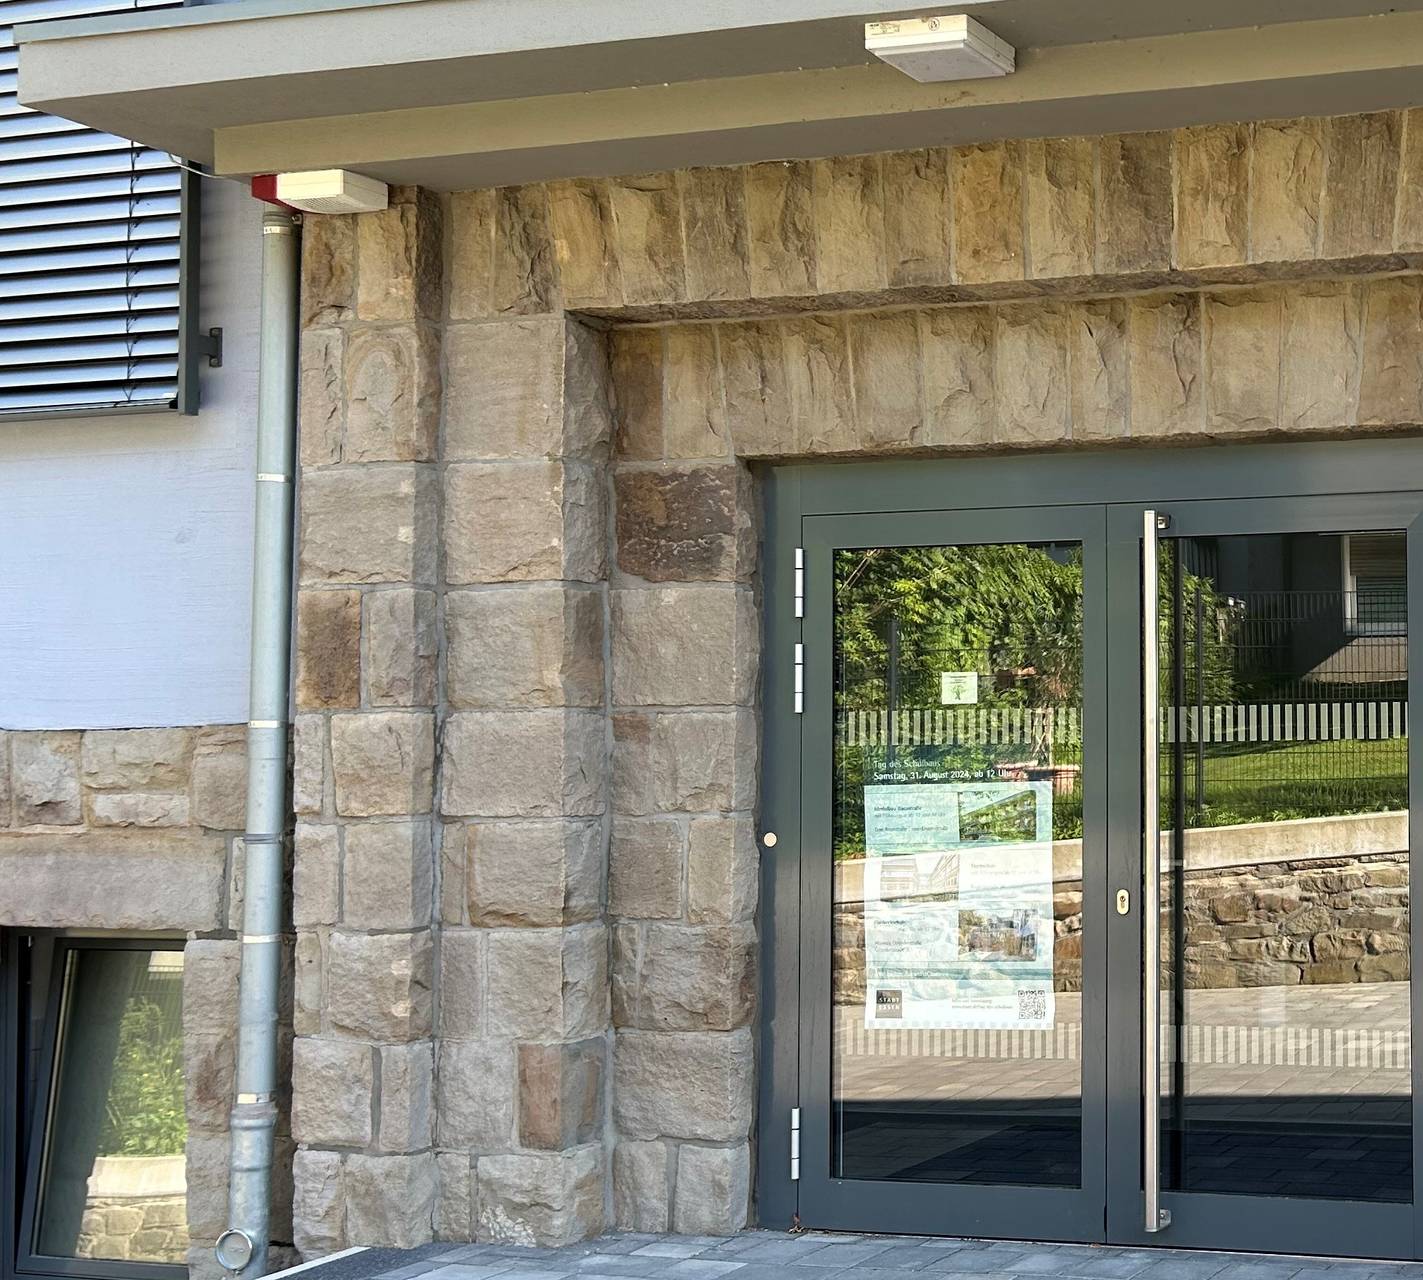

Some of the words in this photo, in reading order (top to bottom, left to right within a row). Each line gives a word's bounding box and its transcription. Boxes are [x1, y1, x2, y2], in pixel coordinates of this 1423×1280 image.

[873, 760, 887, 771] Tag
[873, 771, 909, 782] Samstag,
[910, 771, 922, 779] 31.
[923, 770, 949, 781] August
[950, 770, 972, 779] 2024,
[974, 770, 984, 778] ab
[986, 769, 996, 778] 12
